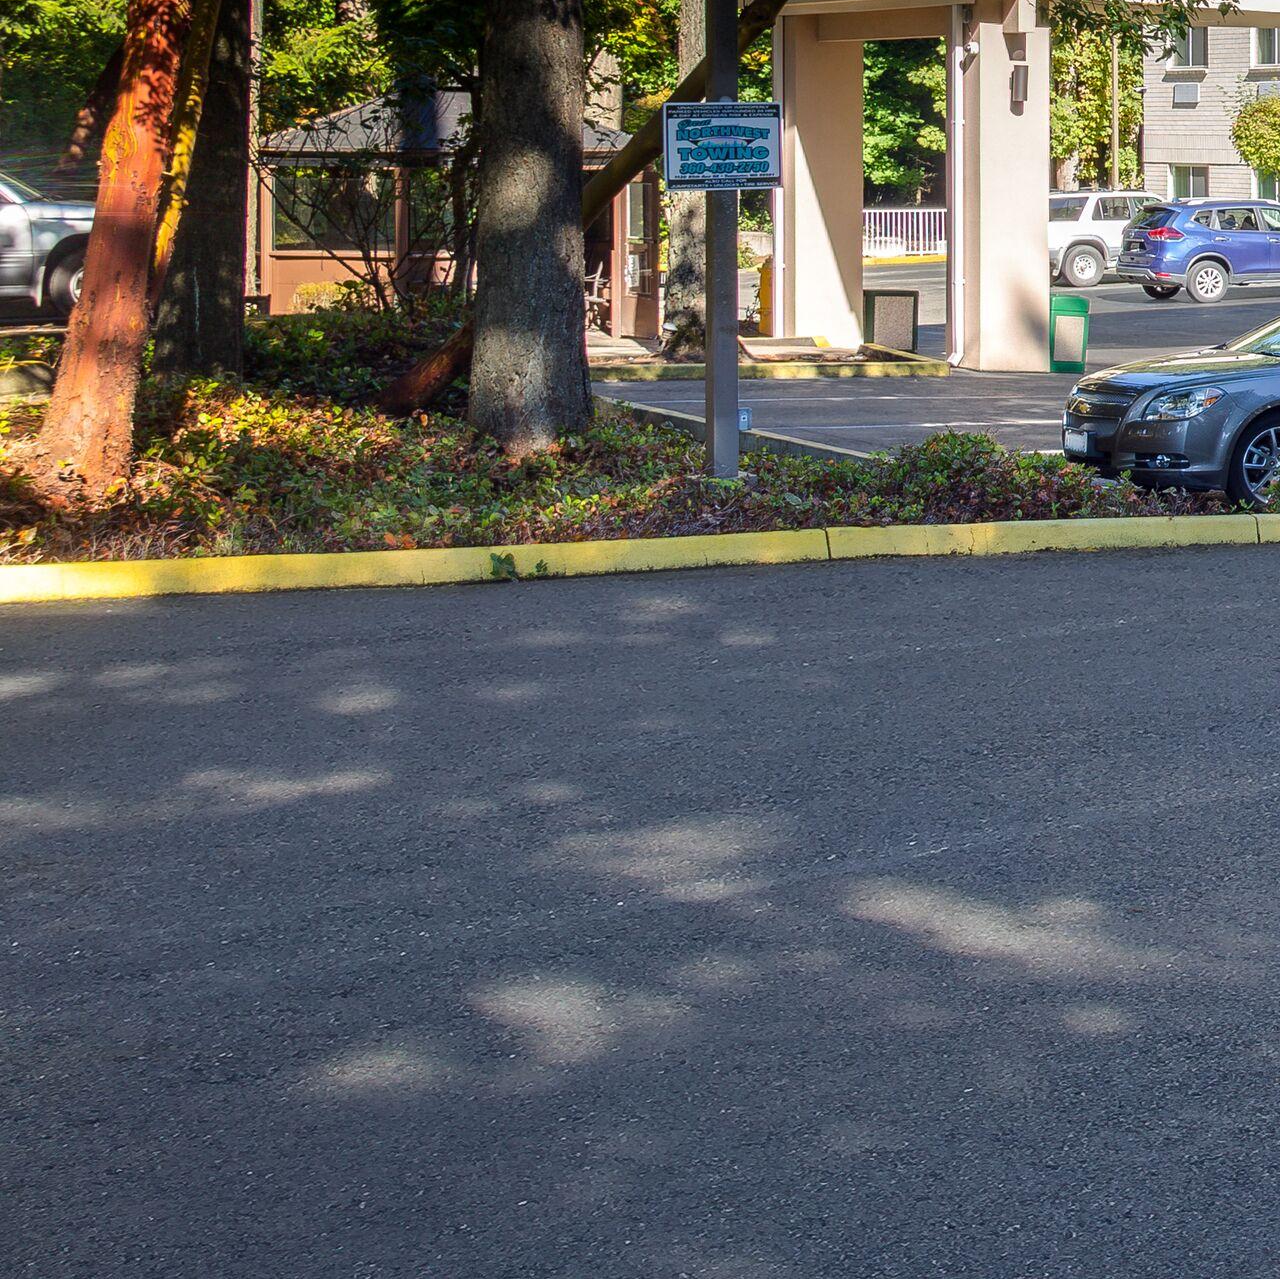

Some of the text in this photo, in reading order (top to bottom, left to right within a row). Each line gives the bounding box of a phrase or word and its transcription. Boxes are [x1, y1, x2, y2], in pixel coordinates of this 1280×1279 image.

[676, 125, 770, 141] NORTHWEST
[677, 146, 770, 161] TOWING
[680, 161, 770, 174] 360-438-2750
